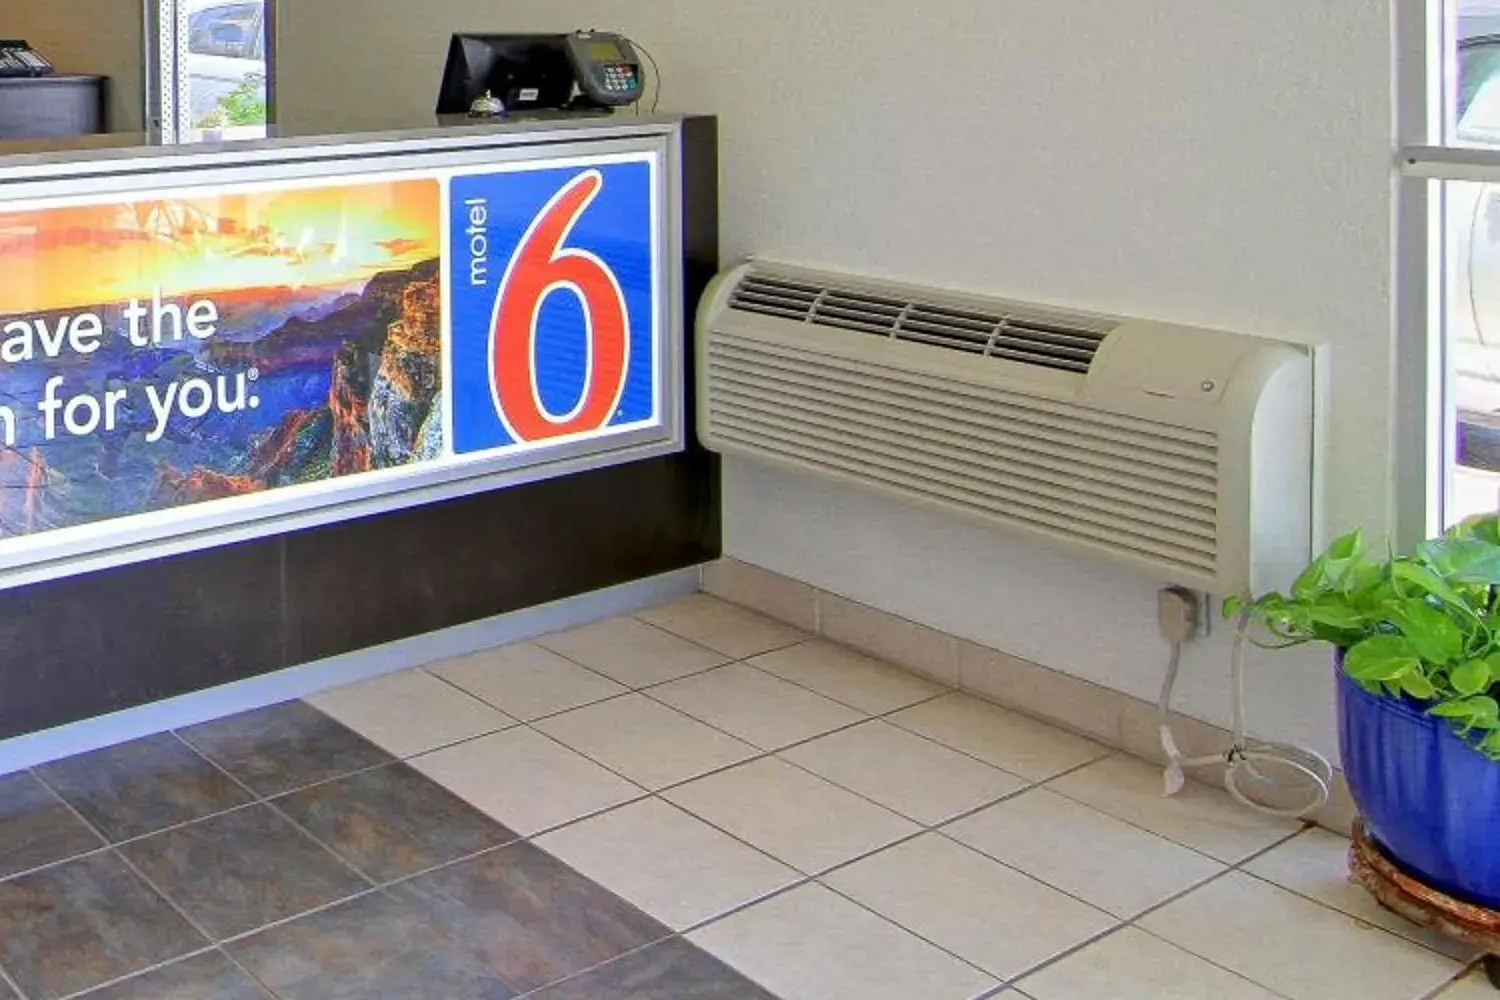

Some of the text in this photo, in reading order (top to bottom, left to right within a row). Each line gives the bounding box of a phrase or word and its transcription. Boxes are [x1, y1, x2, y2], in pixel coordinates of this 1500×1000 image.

[123, 286, 218, 347] the
[465, 168, 631, 444] motel 6
[38, 376, 127, 440] for
